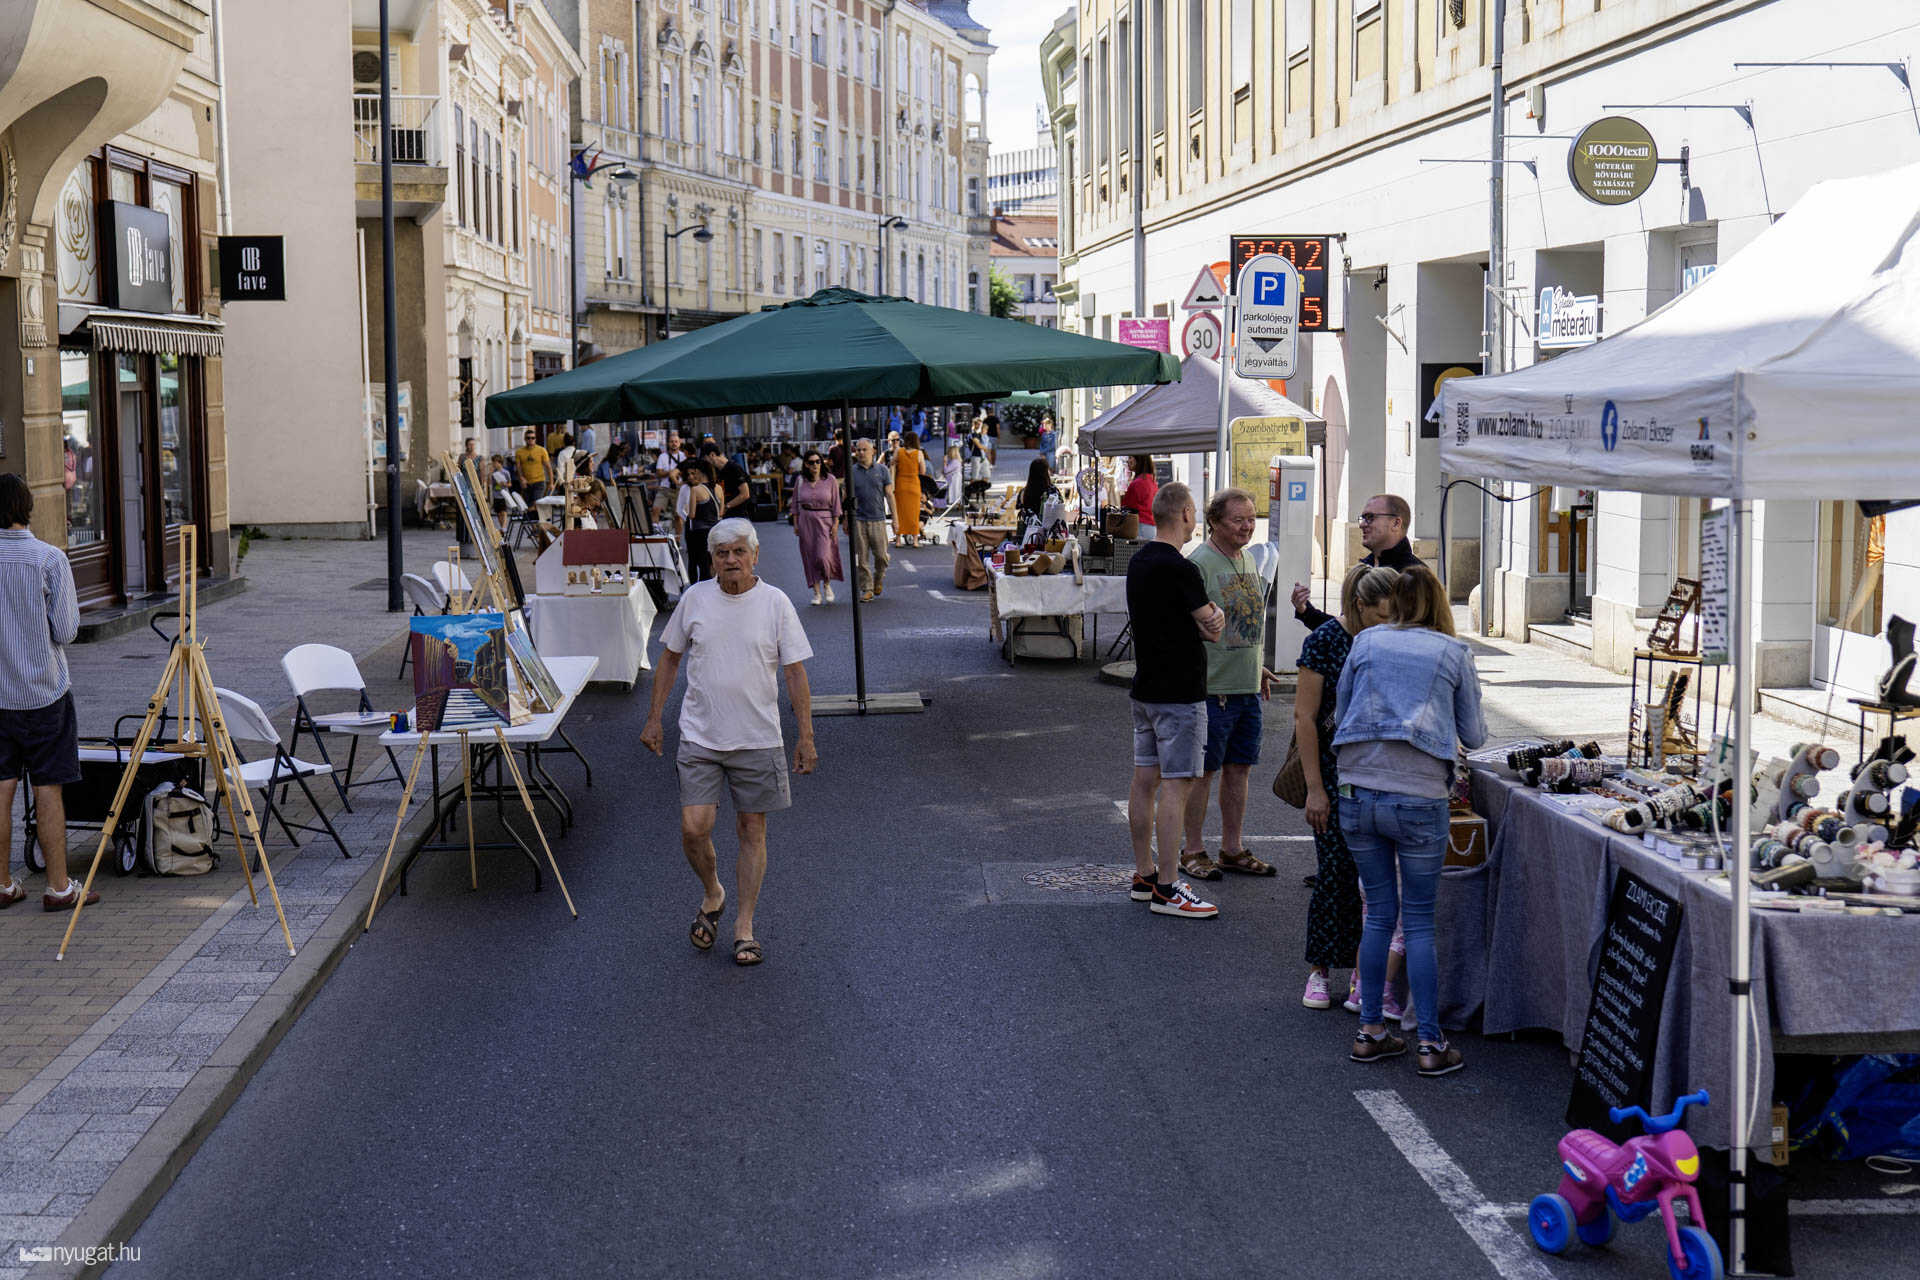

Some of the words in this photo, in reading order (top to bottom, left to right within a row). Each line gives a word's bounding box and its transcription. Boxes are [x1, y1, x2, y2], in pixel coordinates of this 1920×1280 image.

[144, 236, 165, 283] fave
[237, 271, 267, 291] fave
[1261, 276, 1279, 301] P
[1242, 311, 1293, 324] parkolójegy
[1552, 309, 1594, 337] méteráru
[1193, 328, 1213, 349] 30
[1247, 324, 1289, 335] automata
[1244, 356, 1288, 368] jegyváltás
[1476, 411, 1543, 439] www.zolami.hu
[1291, 484, 1304, 499] P
